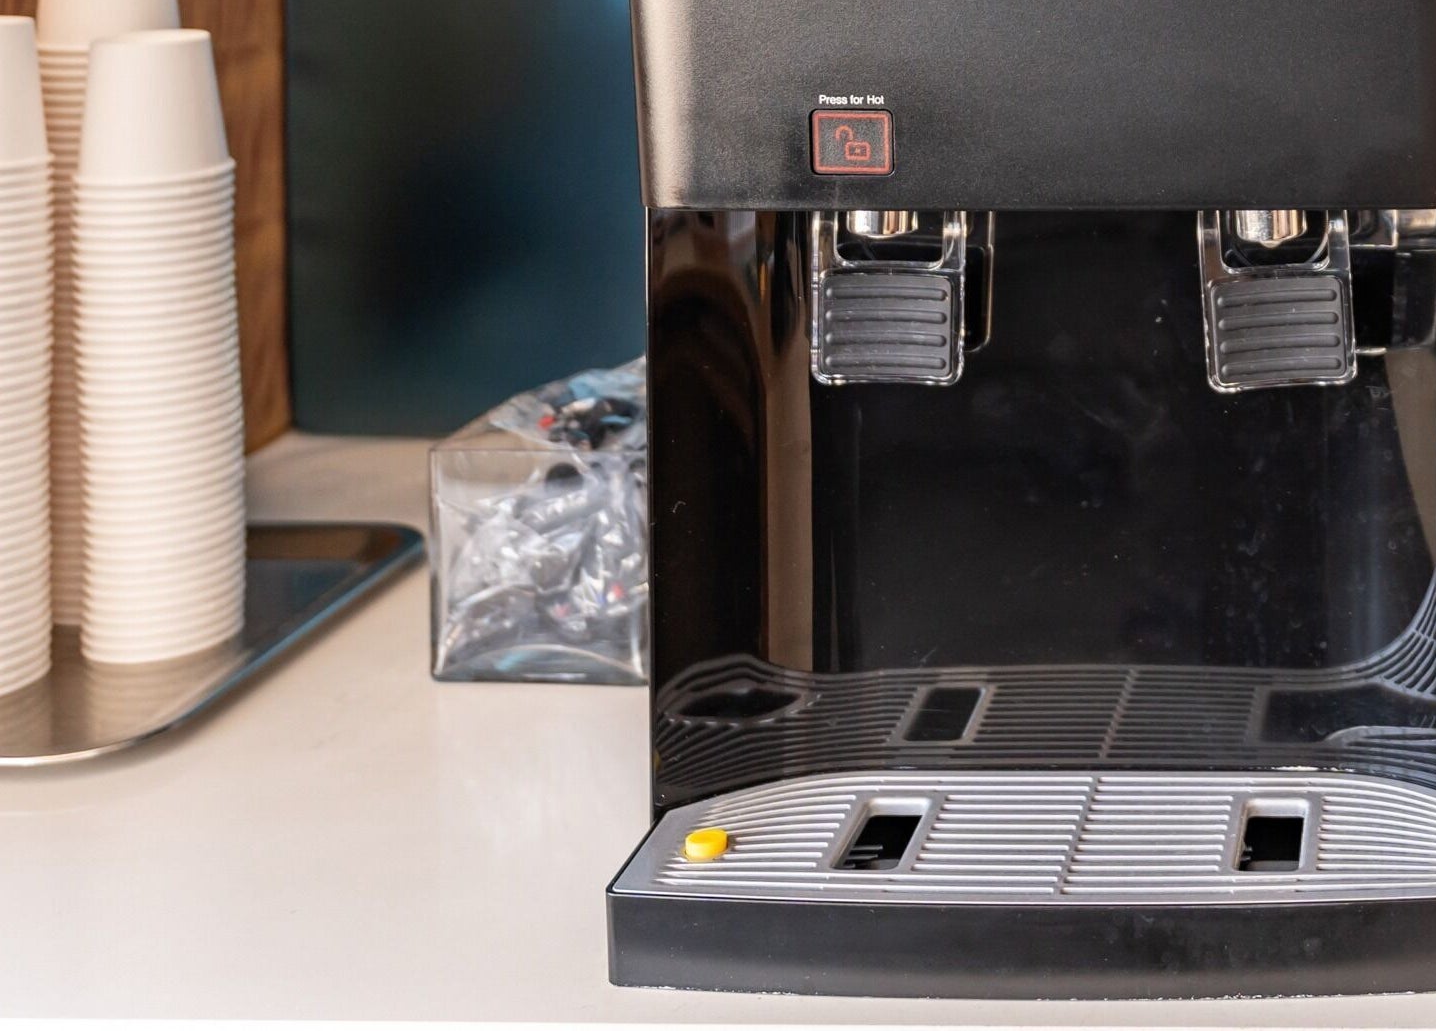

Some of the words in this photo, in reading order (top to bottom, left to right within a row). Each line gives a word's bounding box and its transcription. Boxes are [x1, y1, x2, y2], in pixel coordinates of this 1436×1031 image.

[819, 94, 848, 105] Press
[849, 94, 864, 105] for
[866, 94, 885, 105] Hot
